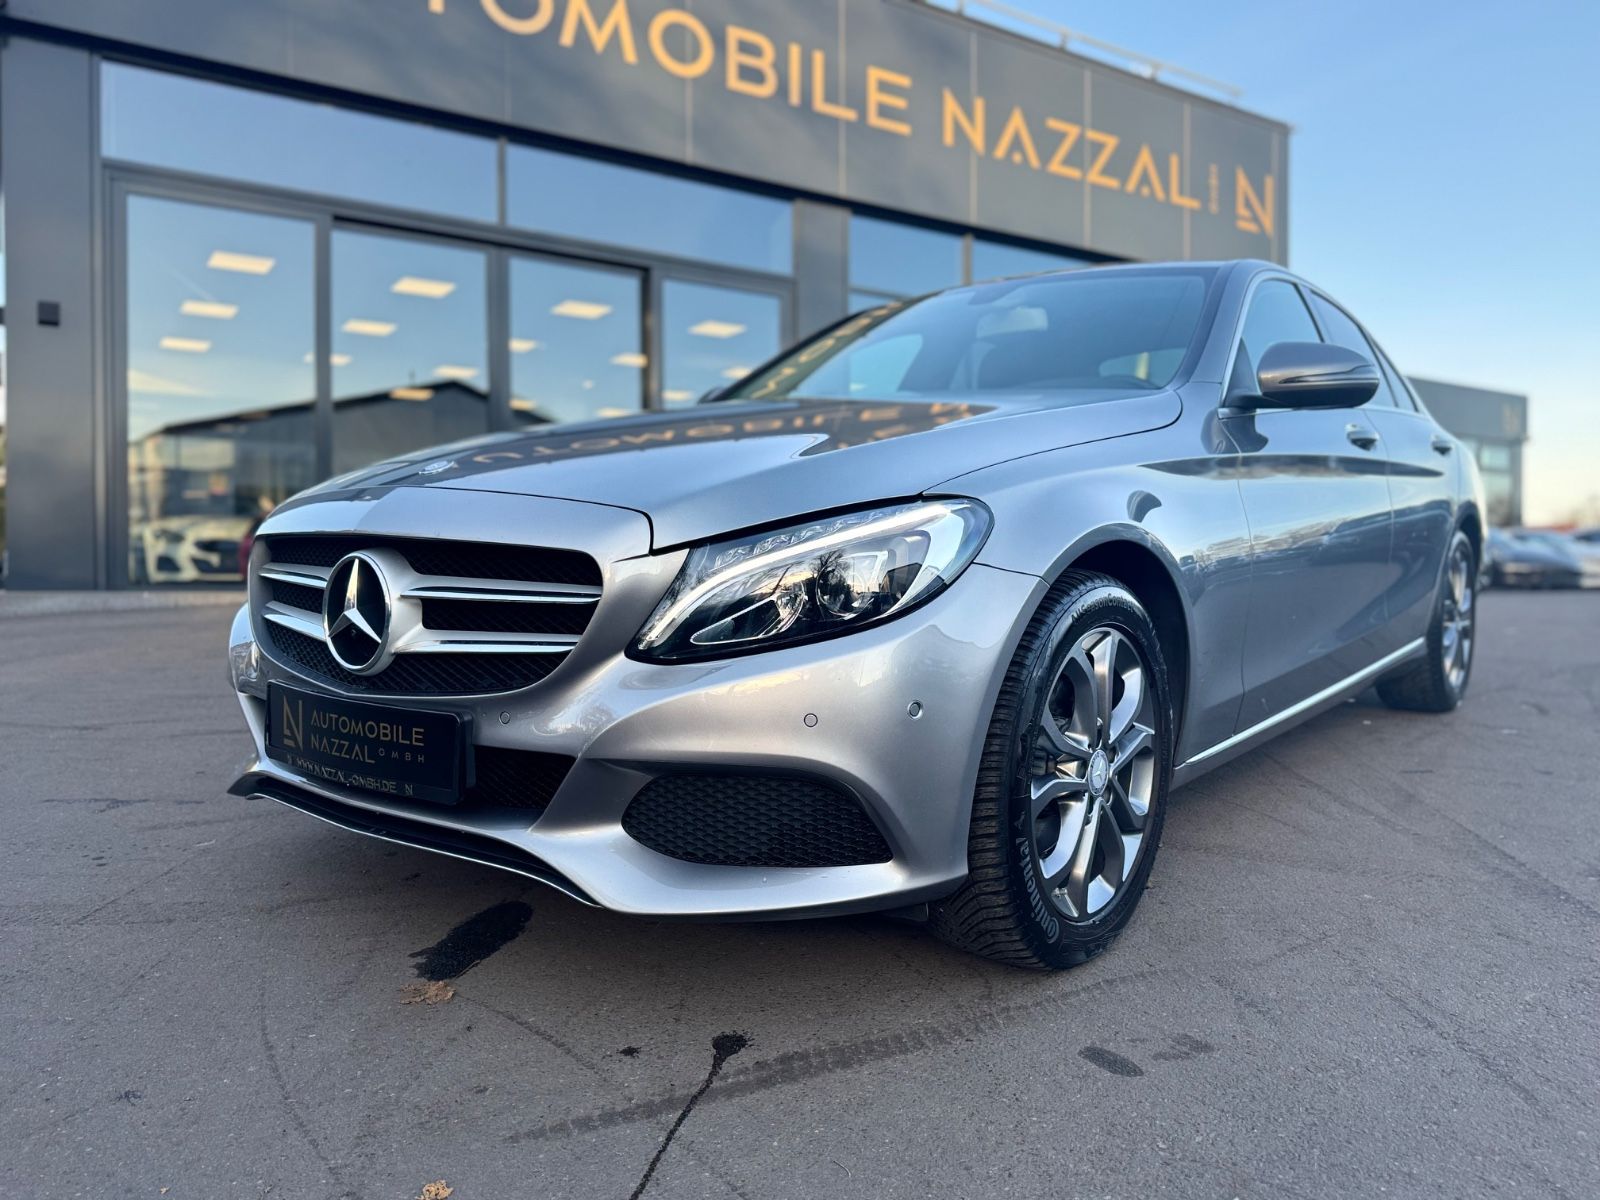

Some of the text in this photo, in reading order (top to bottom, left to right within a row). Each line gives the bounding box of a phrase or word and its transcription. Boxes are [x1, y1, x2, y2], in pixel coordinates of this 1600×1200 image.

[428, 0, 912, 136] MOBILE
[942, 87, 1201, 210] NAZZAL
[310, 709, 425, 747] AUTOMOBILE
[310, 734, 376, 764] NAZZAL
